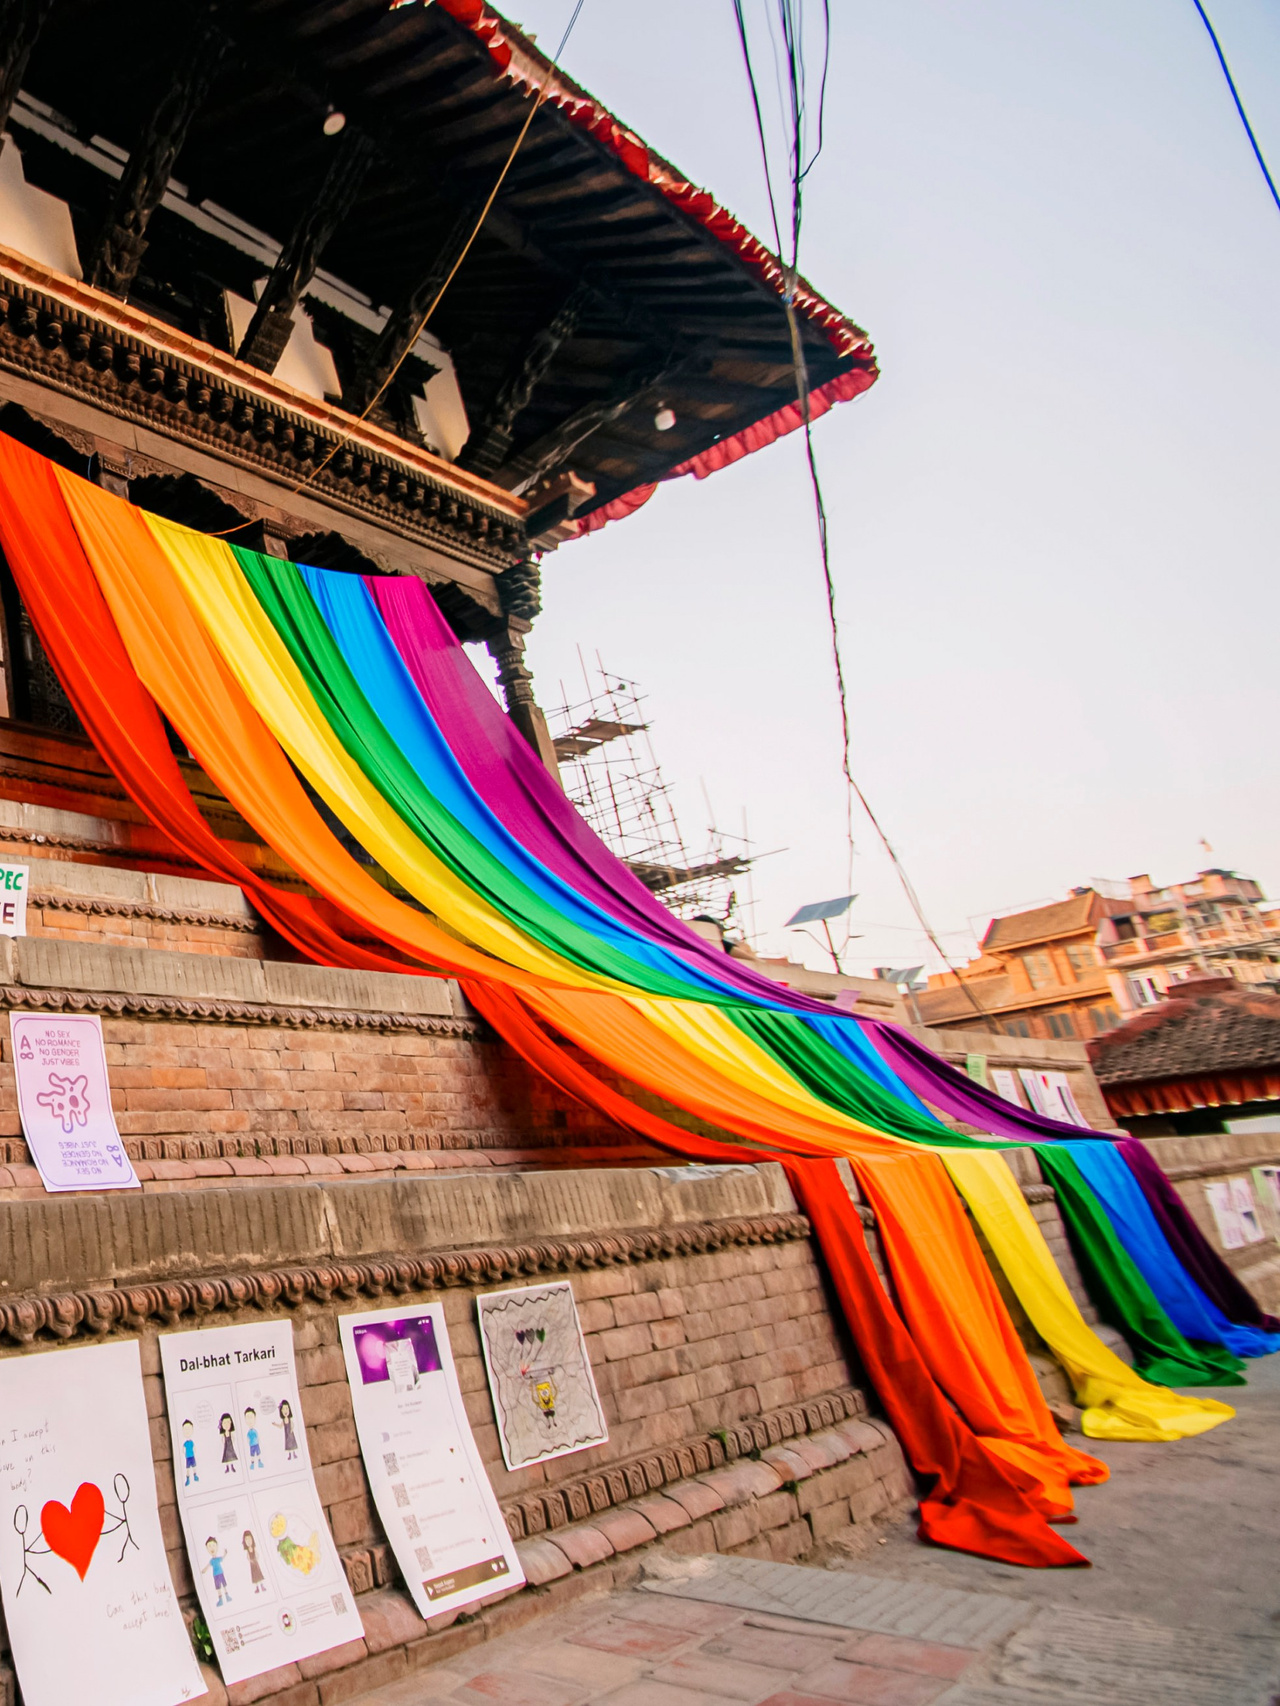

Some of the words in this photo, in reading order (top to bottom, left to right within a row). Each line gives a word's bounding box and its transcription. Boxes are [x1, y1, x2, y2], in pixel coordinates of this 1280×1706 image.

[21, 1035, 31, 1050] A
[48, 1039, 81, 1047] ROMANCE
[39, 1048, 50, 1056] NO
[52, 1048, 79, 1056] GENDER
[111, 1154, 122, 1167] A
[180, 1353, 231, 1372] Dal-bhat
[234, 1346, 275, 1363] Tarkari
